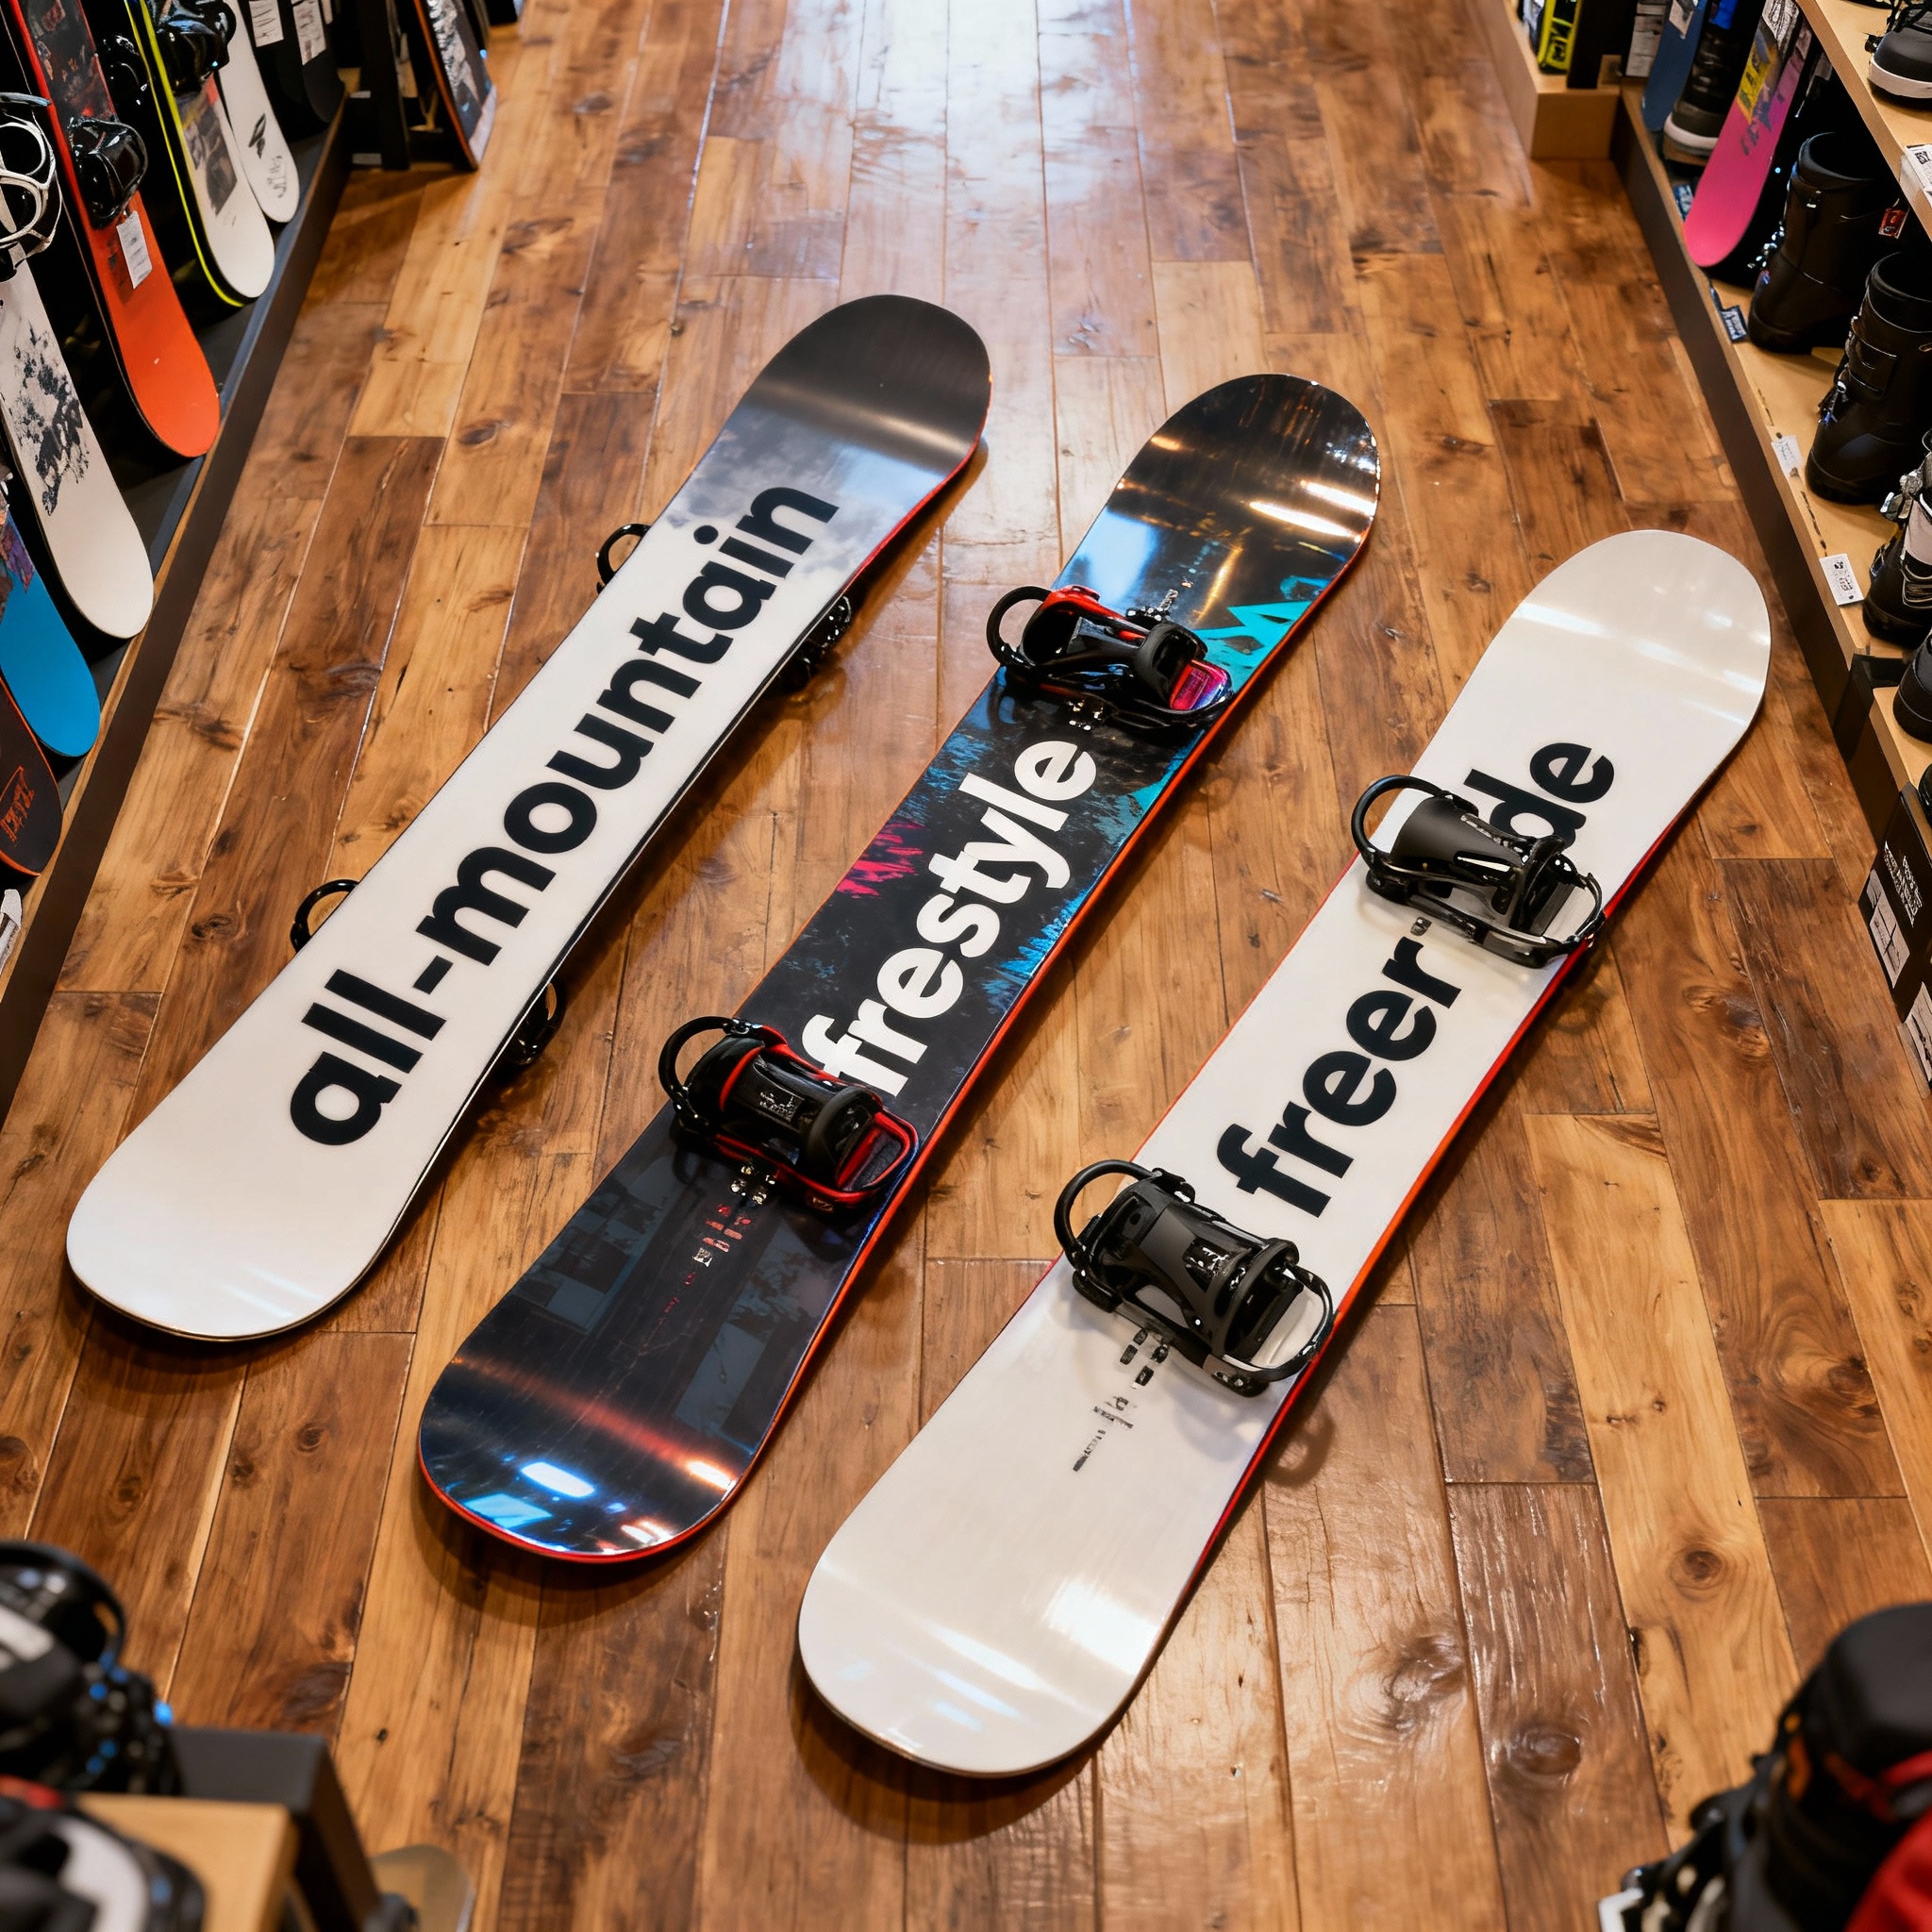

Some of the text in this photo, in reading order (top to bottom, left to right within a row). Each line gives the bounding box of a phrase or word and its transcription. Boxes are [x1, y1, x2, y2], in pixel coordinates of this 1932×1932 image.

[291, 487, 840, 1145] all-mountain
[802, 741, 1096, 1096] frestyle
[1217, 742, 1614, 1218] freerde
